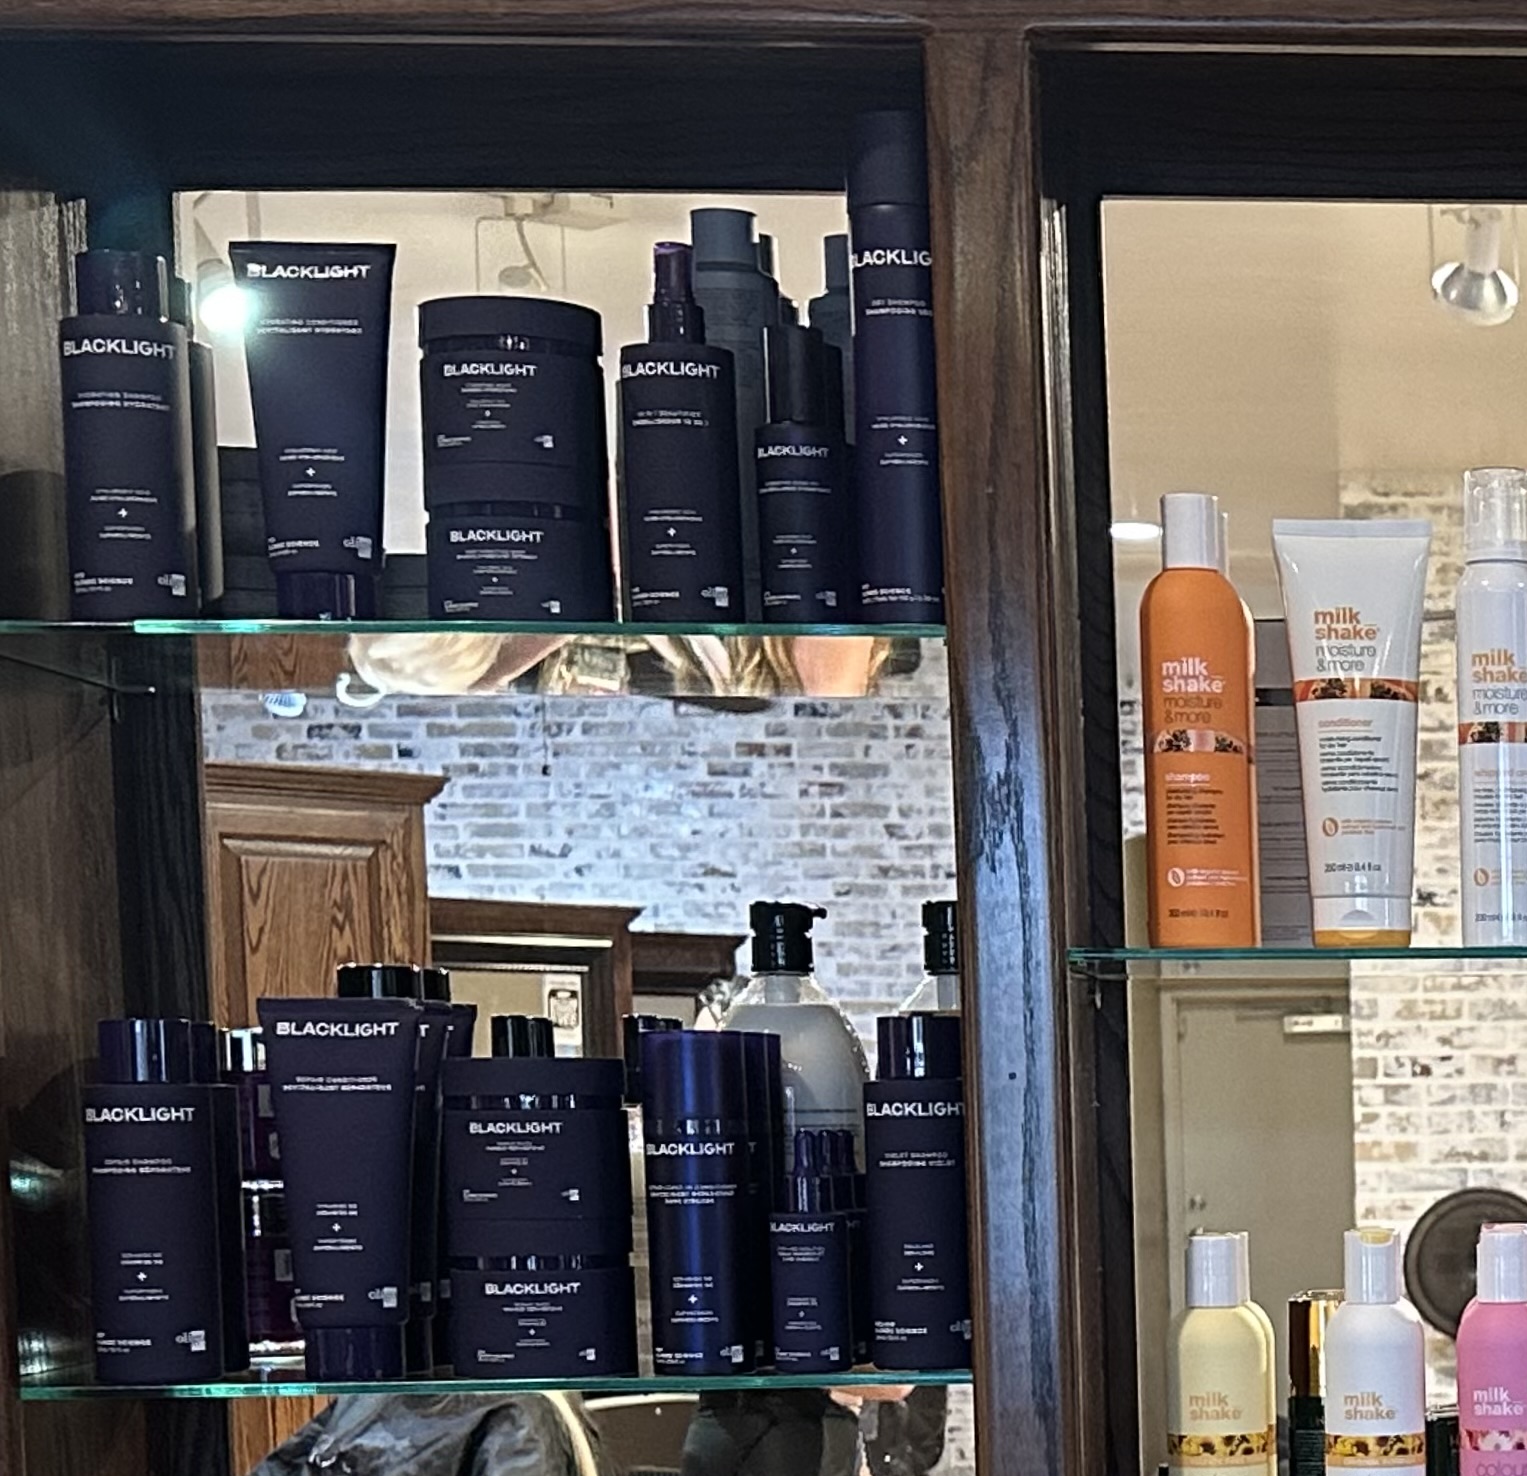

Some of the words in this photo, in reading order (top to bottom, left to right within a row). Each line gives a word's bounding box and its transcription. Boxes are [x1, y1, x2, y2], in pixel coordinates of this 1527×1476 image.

[248, 264, 370, 279] BLACKLIGHT
[64, 339, 176, 360] BLACKLIGHT
[444, 364, 537, 377] BLACKLIGHT
[622, 362, 721, 378] BLACKLIGHT
[758, 445, 829, 459] BLACKLIGHT
[450, 530, 543, 543] BLACKLIGHT
[1315, 624, 1377, 640] shake
[1163, 676, 1223, 693] shake
[1473, 687, 1527, 700] moisture
[277, 1022, 398, 1036] BLACKLIGHT
[86, 1108, 195, 1122] BLACKLIGHT
[469, 1122, 563, 1134] BLACKLIGHT
[647, 1142, 735, 1155] BLACKLIGHT
[770, 1222, 834, 1233] BLACKLIGHT
[485, 1282, 580, 1295] BLACKLIGHT
[1190, 1407, 1241, 1420] shake
[1345, 1408, 1396, 1420] shake
[1474, 1402, 1524, 1416] shake
